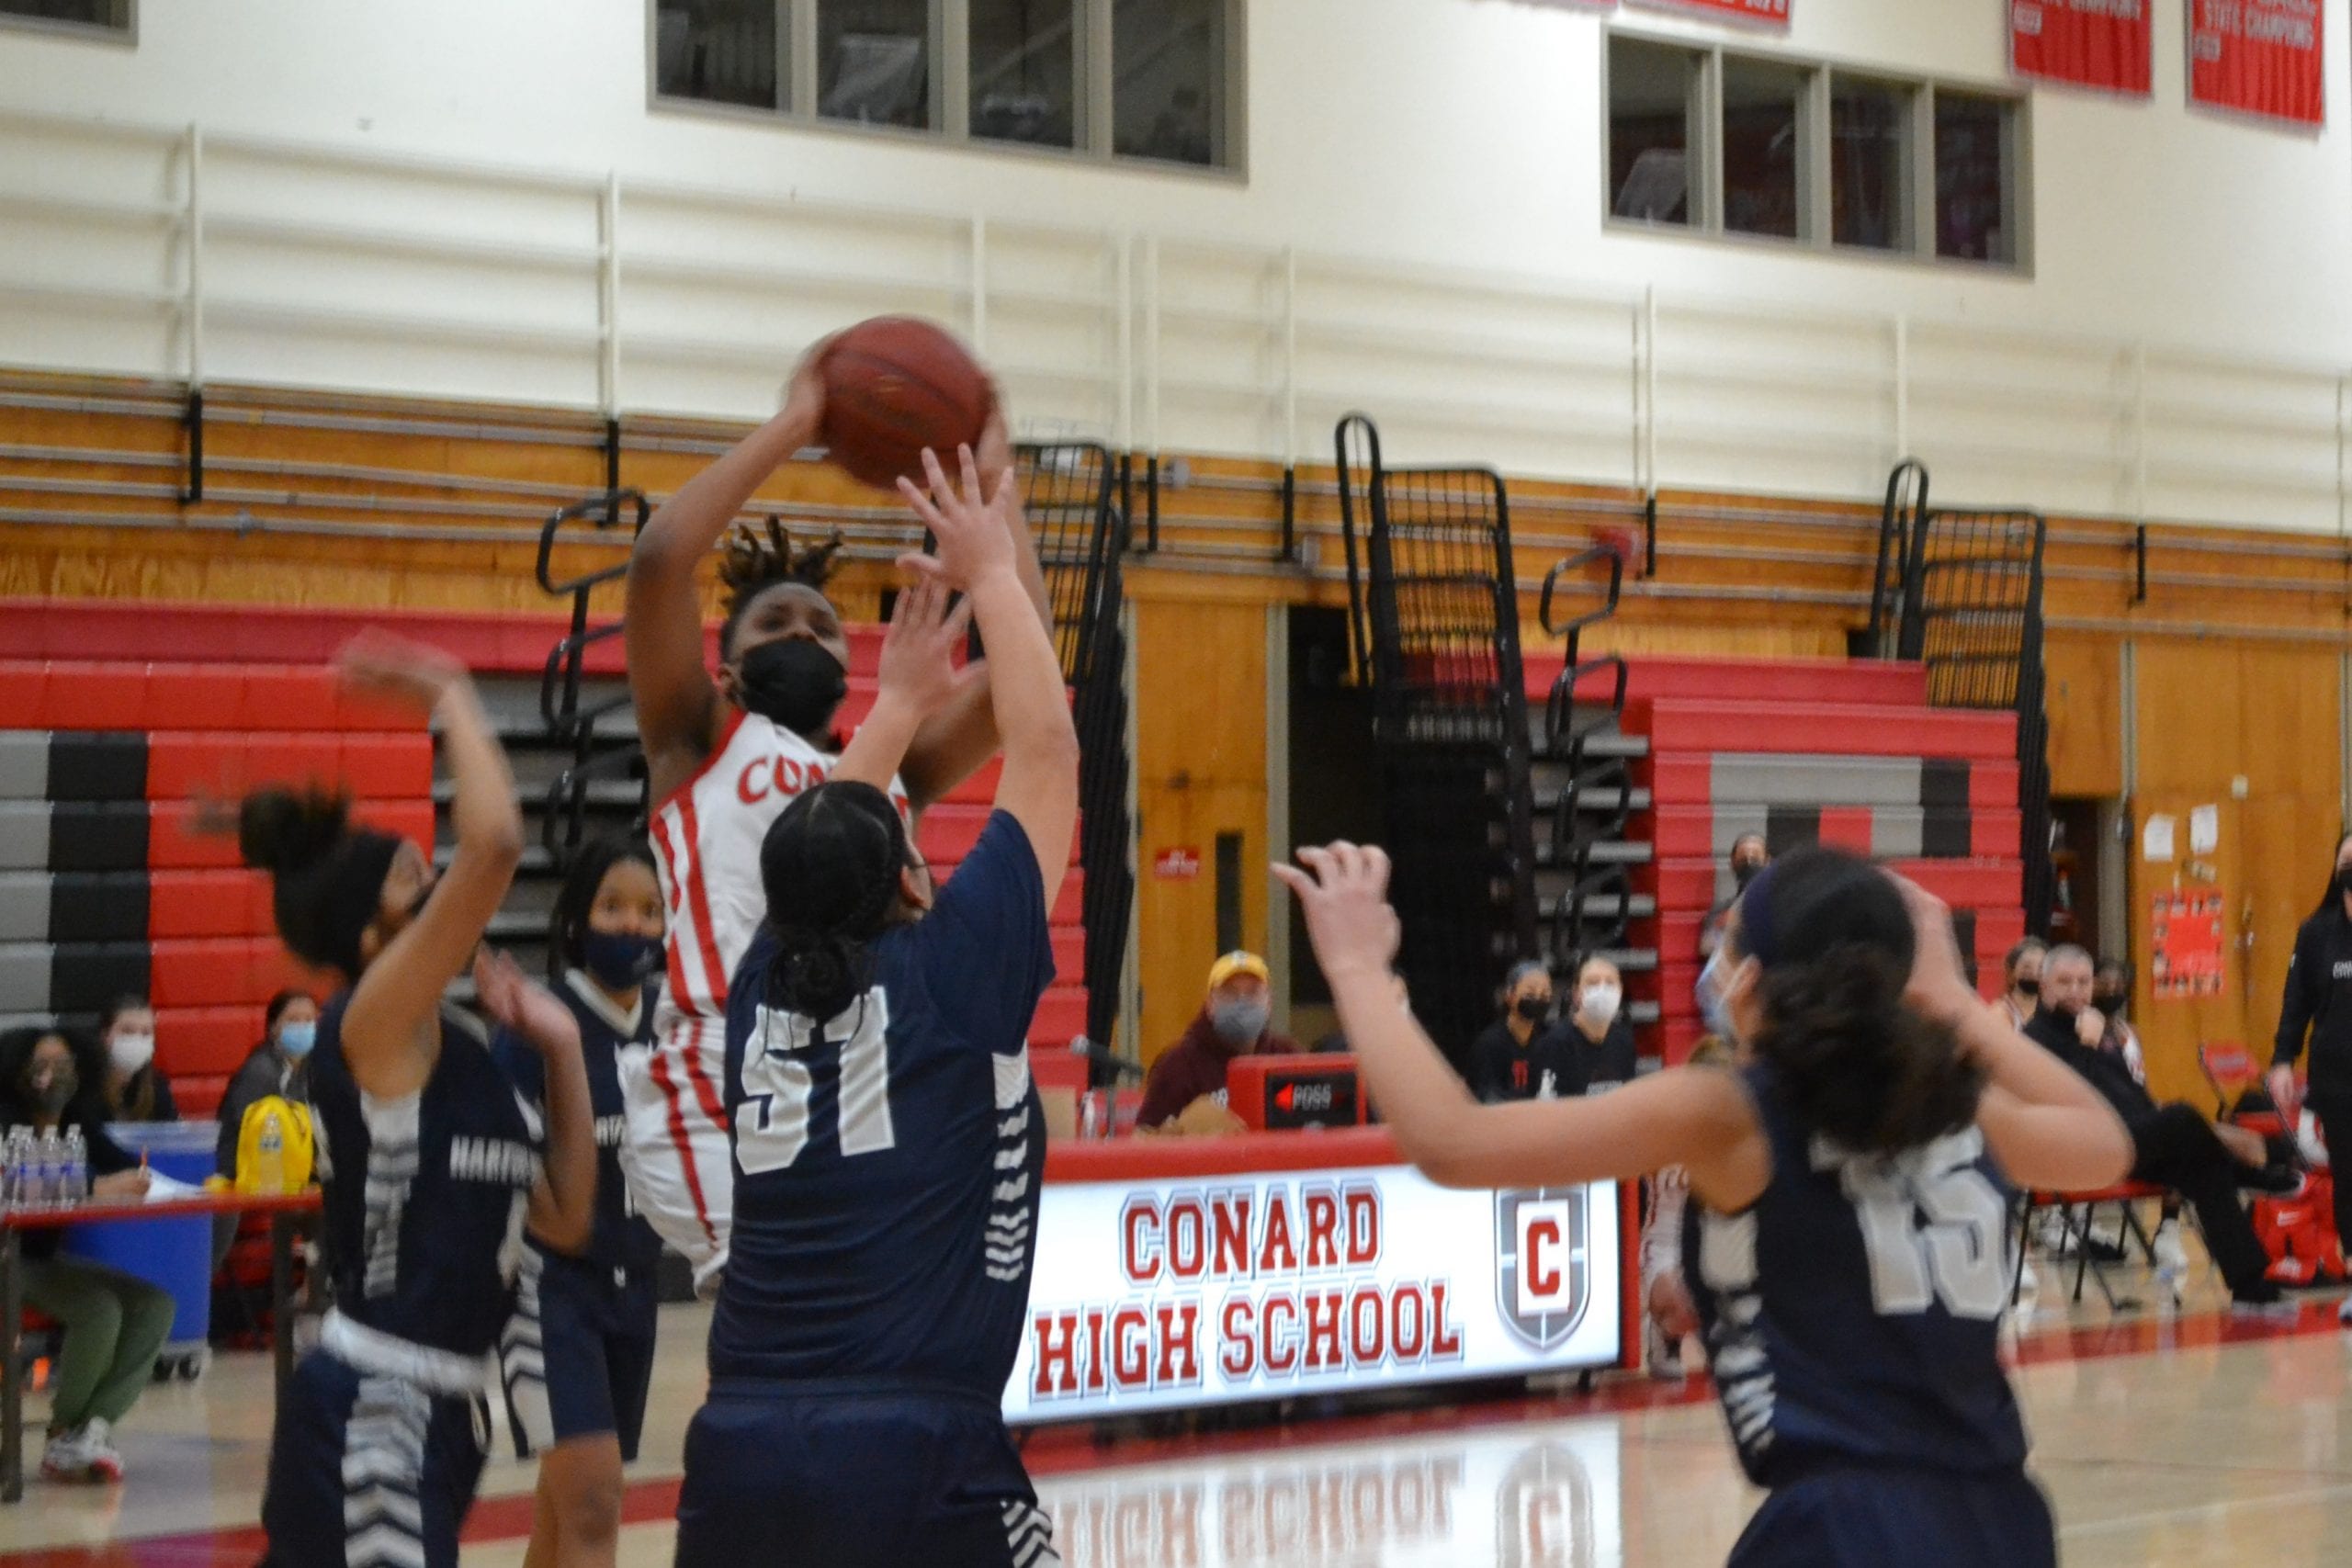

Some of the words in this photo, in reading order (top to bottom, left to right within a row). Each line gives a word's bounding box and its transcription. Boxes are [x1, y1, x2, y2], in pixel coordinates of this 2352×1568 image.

[734, 985, 896, 1176] 51
[1122, 1182, 1382, 1283] CONARD
[1525, 1216, 1562, 1297] C
[1032, 1299, 1201, 1397] HIGH
[1219, 1279, 1464, 1379] SCHOOL
